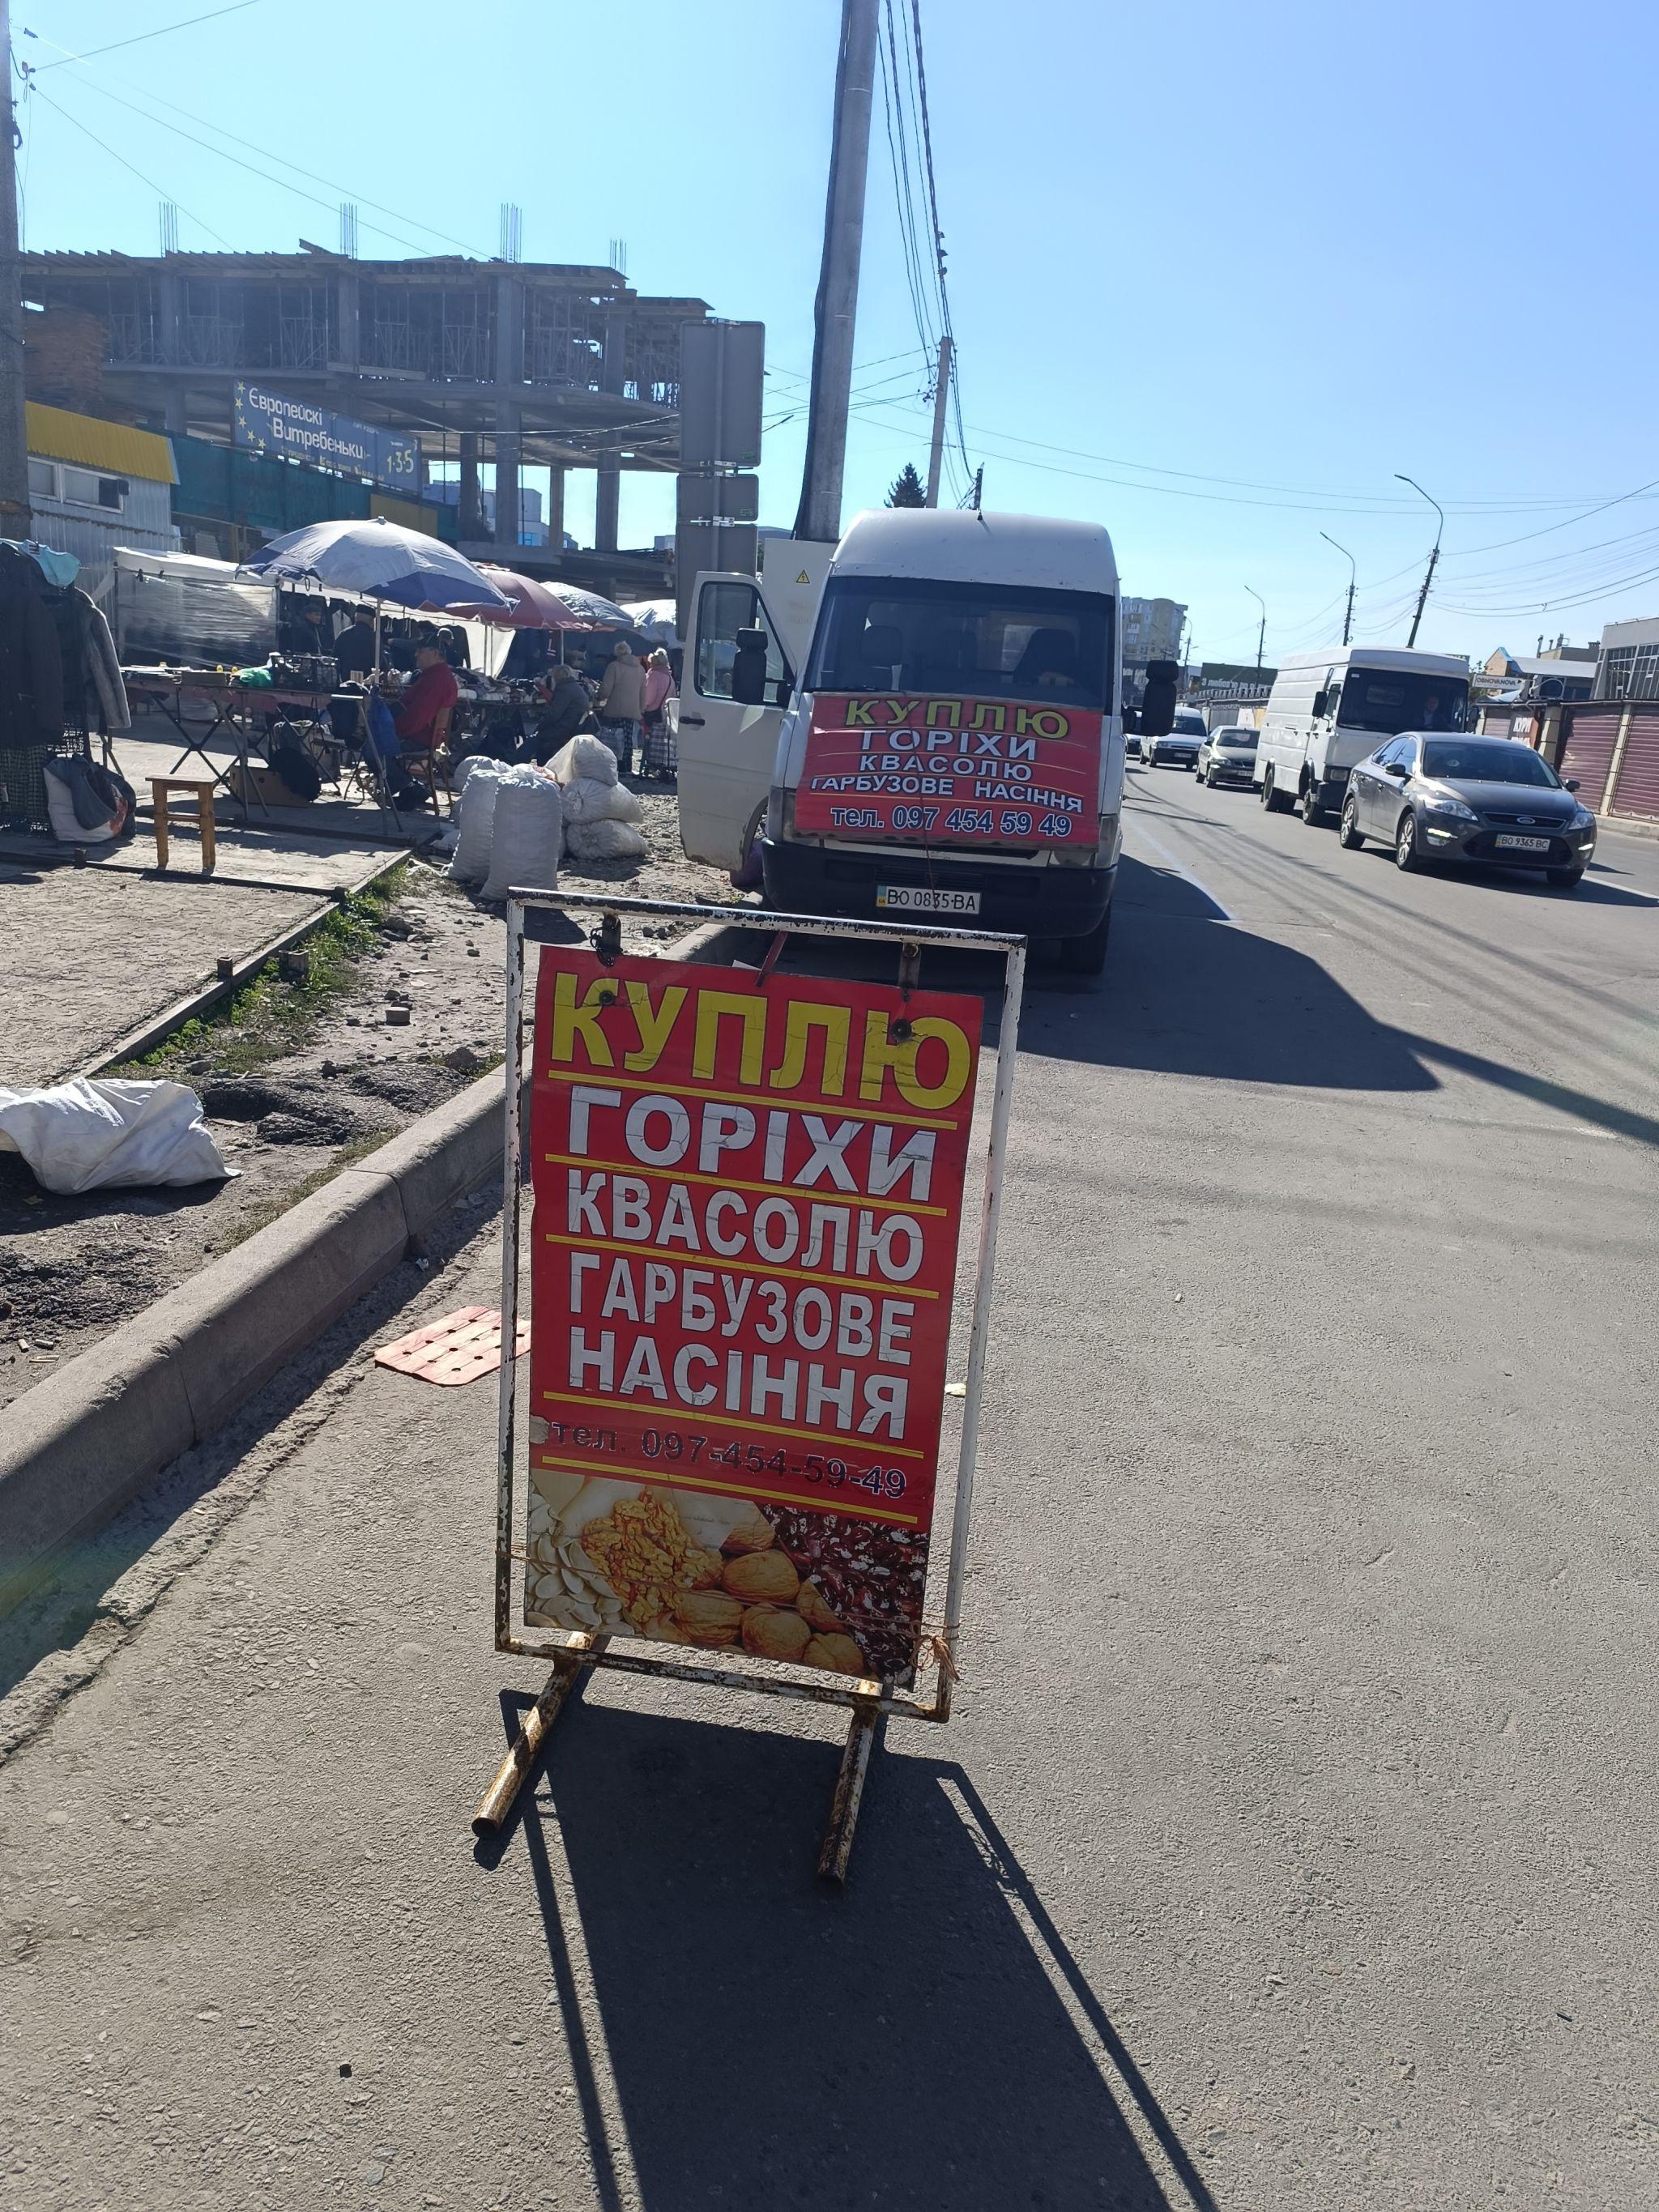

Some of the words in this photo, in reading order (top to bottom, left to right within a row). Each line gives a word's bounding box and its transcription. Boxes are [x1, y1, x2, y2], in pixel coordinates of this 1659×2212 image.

[272, 417, 364, 459] Витребеньки
[845, 700, 1069, 739] КУПЛЮ
[862, 730, 1037, 761] ГОРІХИ
[859, 755, 1032, 782] КВАСОЛЮ
[811, 775, 954, 796] ГАРБУЗОВЕ
[975, 782, 1083, 813] НАСІННЯ
[830, 807, 885, 829] тел.
[892, 805, 940, 831] 097
[945, 808, 994, 833] 454
[1000, 811, 1032, 836] 59
[1038, 813, 1073, 837] 49
[551, 972, 971, 1110] КУПЛЮ
[568, 1085, 937, 1203] ГОРІХИ
[567, 1169, 925, 1282] КВАСОЛЮ
[569, 1251, 915, 1366] ГАРБУЗОВЕ
[568, 1325, 911, 1441] НАСІННЯ
[550, 1421, 627, 1452] тел.
